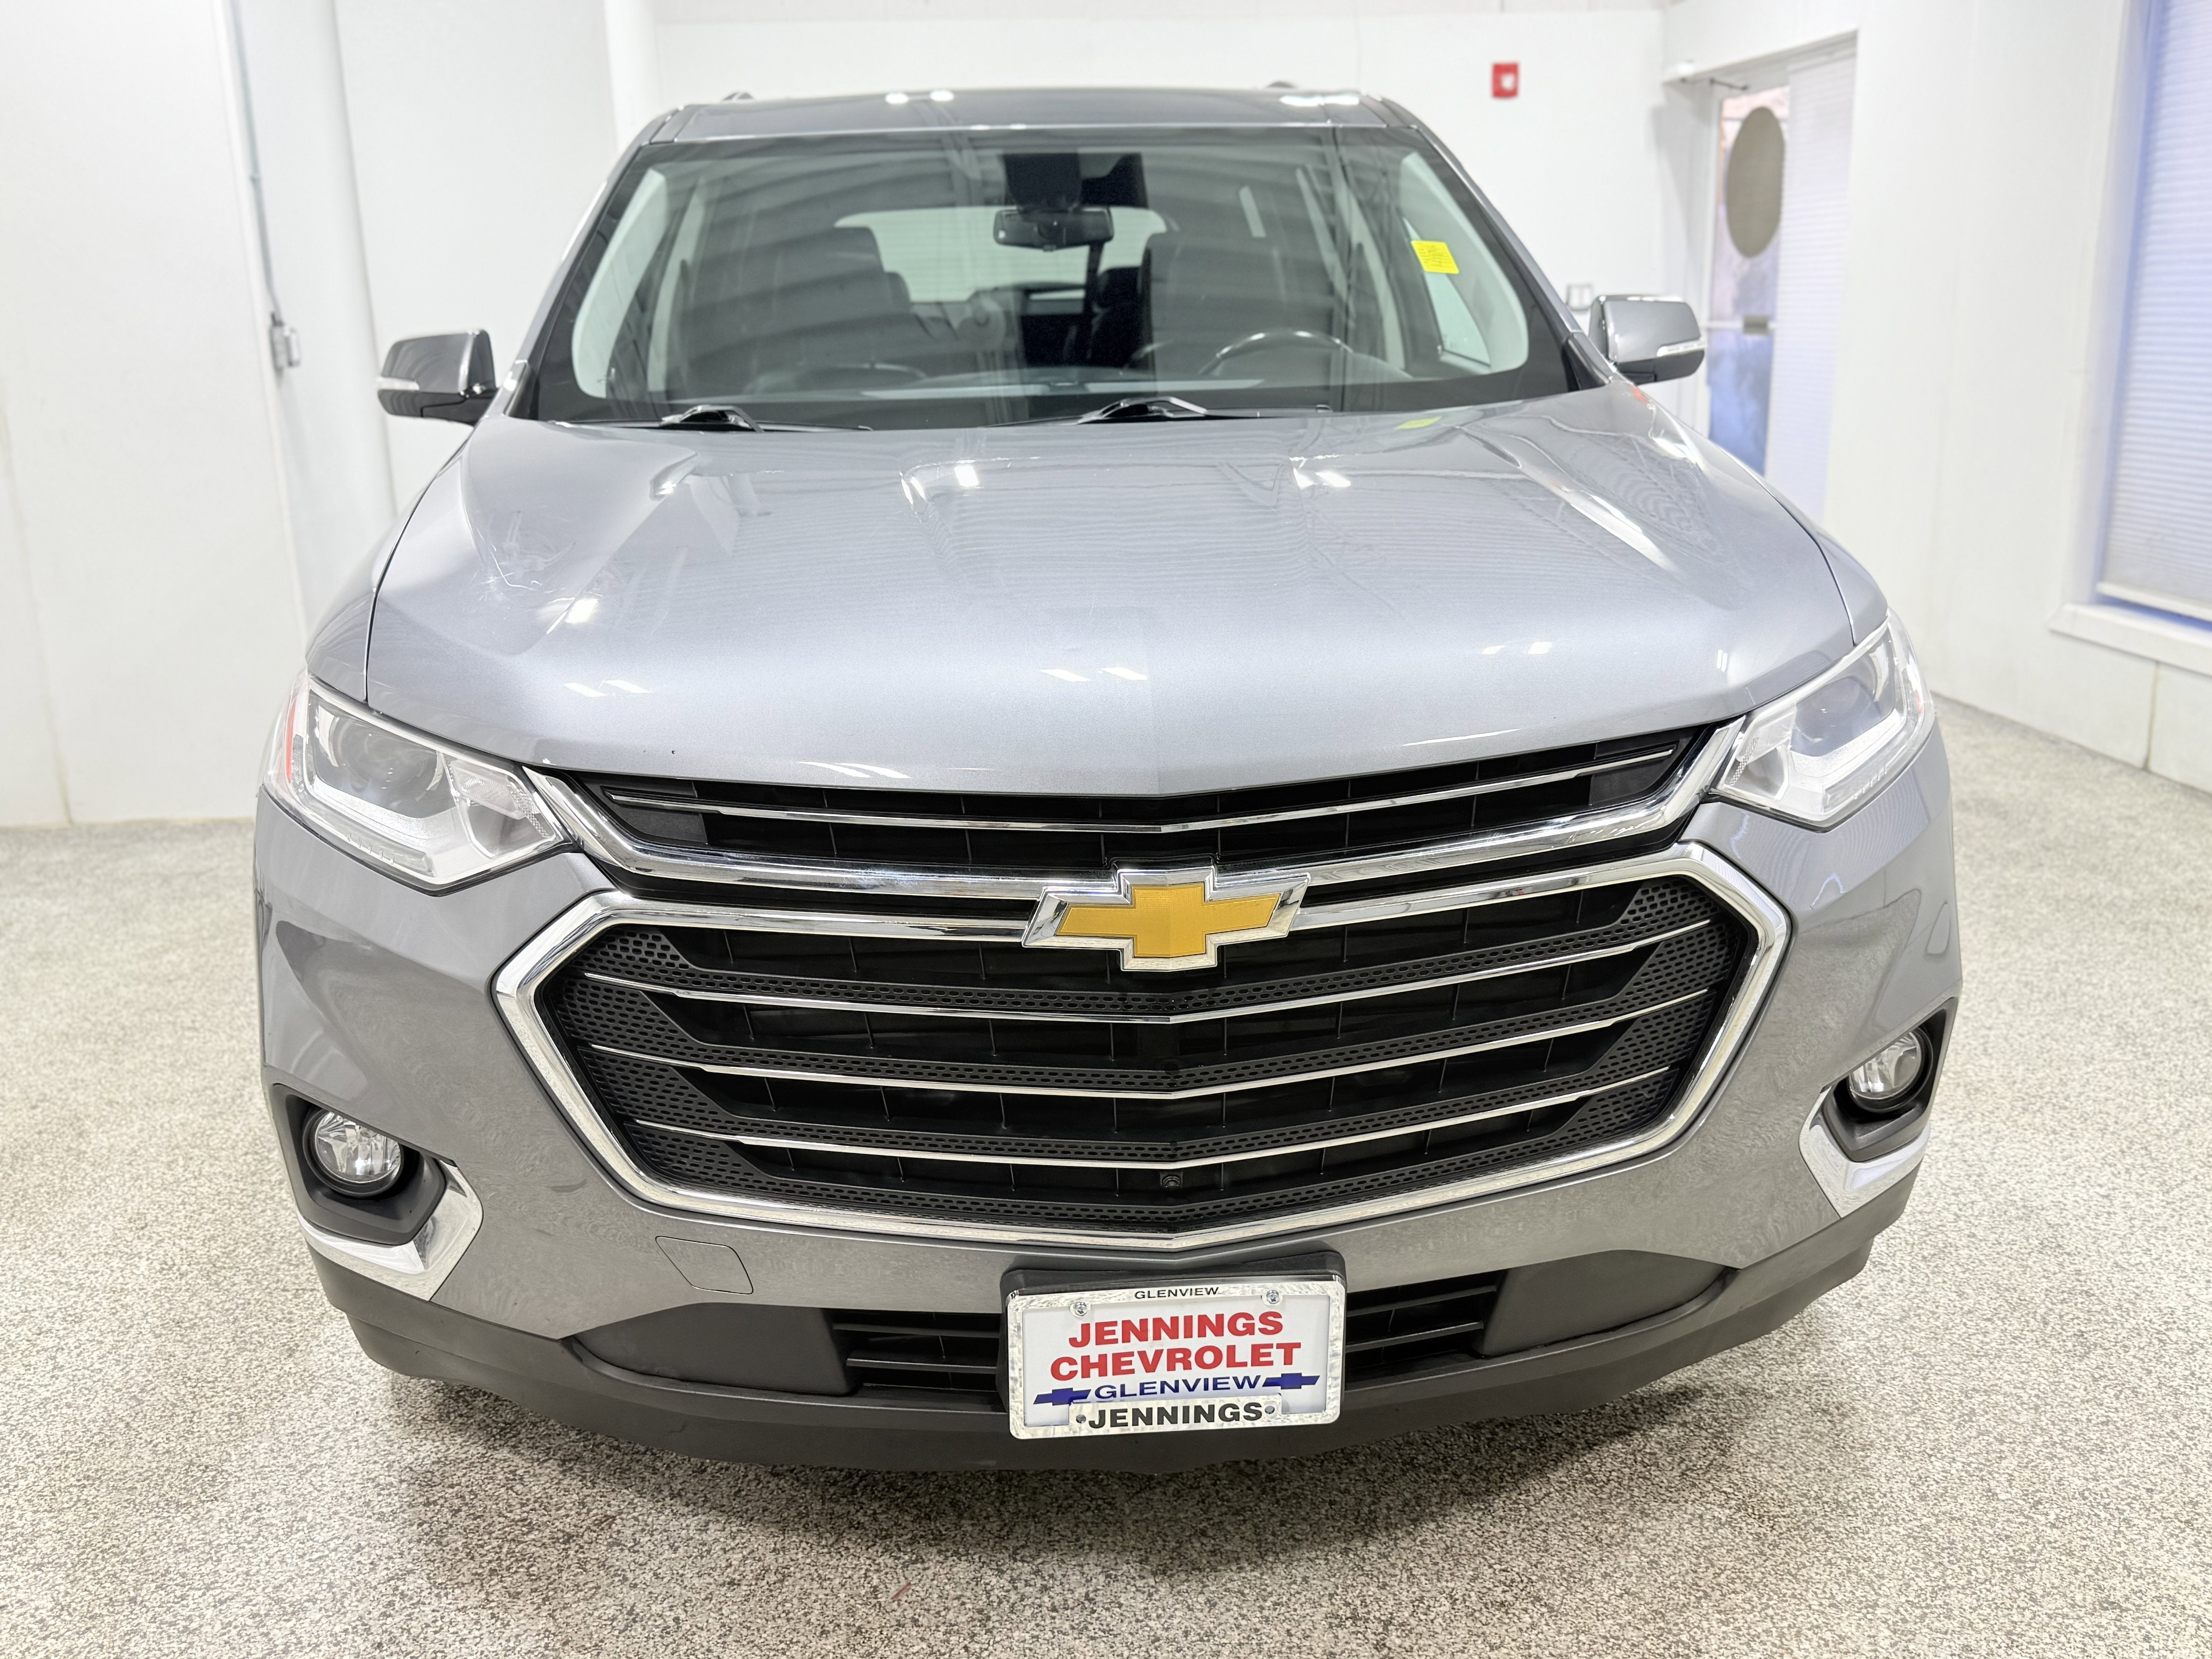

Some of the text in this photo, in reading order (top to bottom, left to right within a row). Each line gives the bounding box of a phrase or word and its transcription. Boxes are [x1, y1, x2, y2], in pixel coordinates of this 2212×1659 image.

[1135, 1287, 1219, 1299] GLENVIEW
[1068, 1311, 1283, 1348] JENNINGS
[1050, 1342, 1301, 1381] CHEVROLET
[1095, 1375, 1261, 1399] GLENVIEW
[1088, 1402, 1262, 1429] JENNINGS
